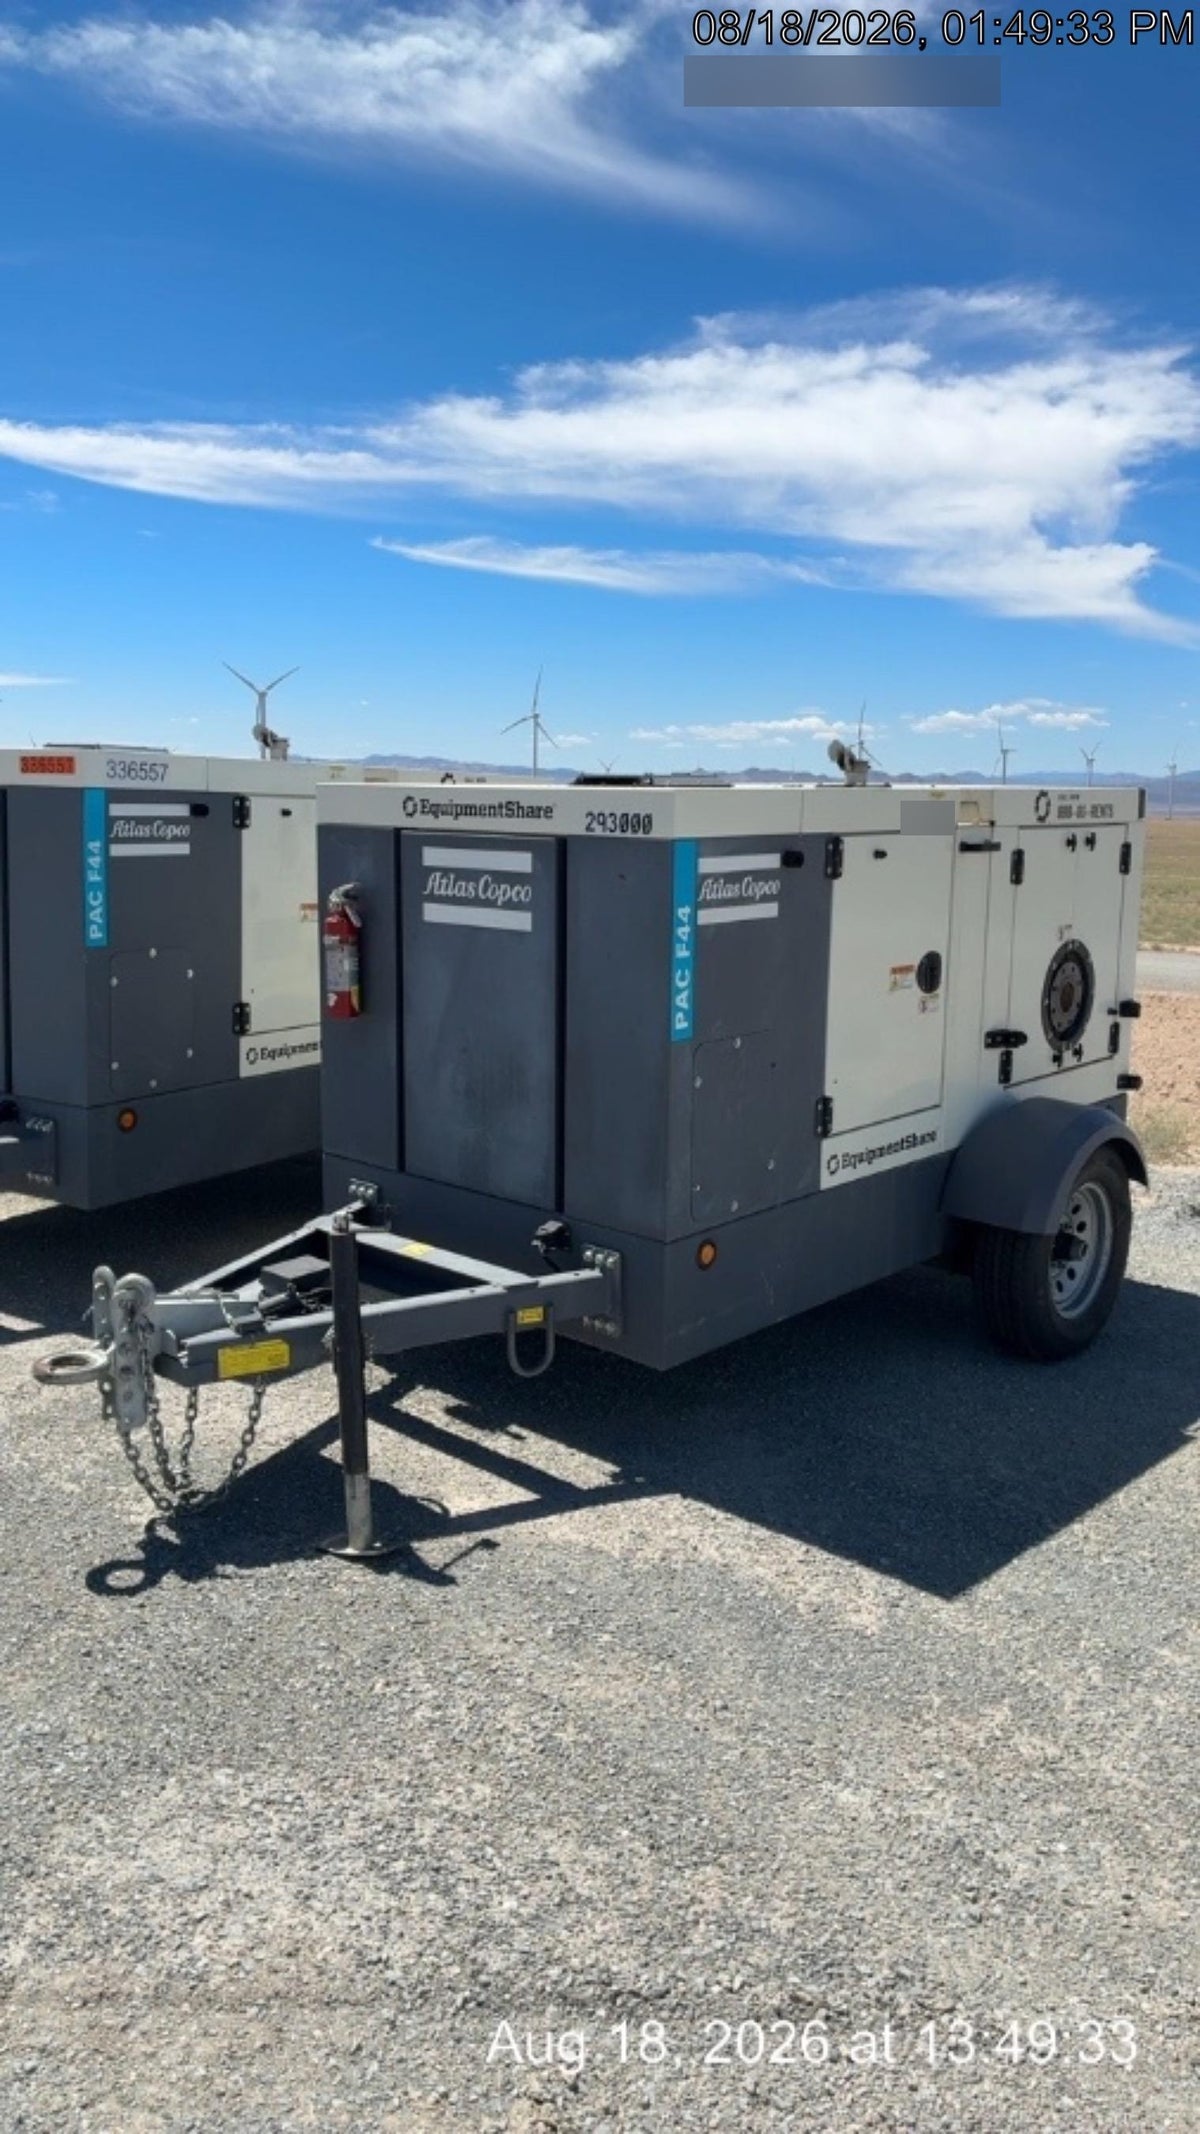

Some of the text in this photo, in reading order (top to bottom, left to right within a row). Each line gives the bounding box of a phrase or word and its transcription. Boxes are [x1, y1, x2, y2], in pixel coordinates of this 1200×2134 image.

[106, 759, 169, 783] 336557
[419, 798, 554, 820] EquipmentShare
[110, 820, 190, 840] Atlas Copco
[585, 811, 653, 835] 293000
[86, 840, 103, 940] PAC F44
[423, 872, 532, 906] Atlas Copco
[698, 876, 781, 901] Atlas Copco
[674, 906, 692, 1031] PAC F44
[841, 1130, 938, 1170] EquipmentShare
